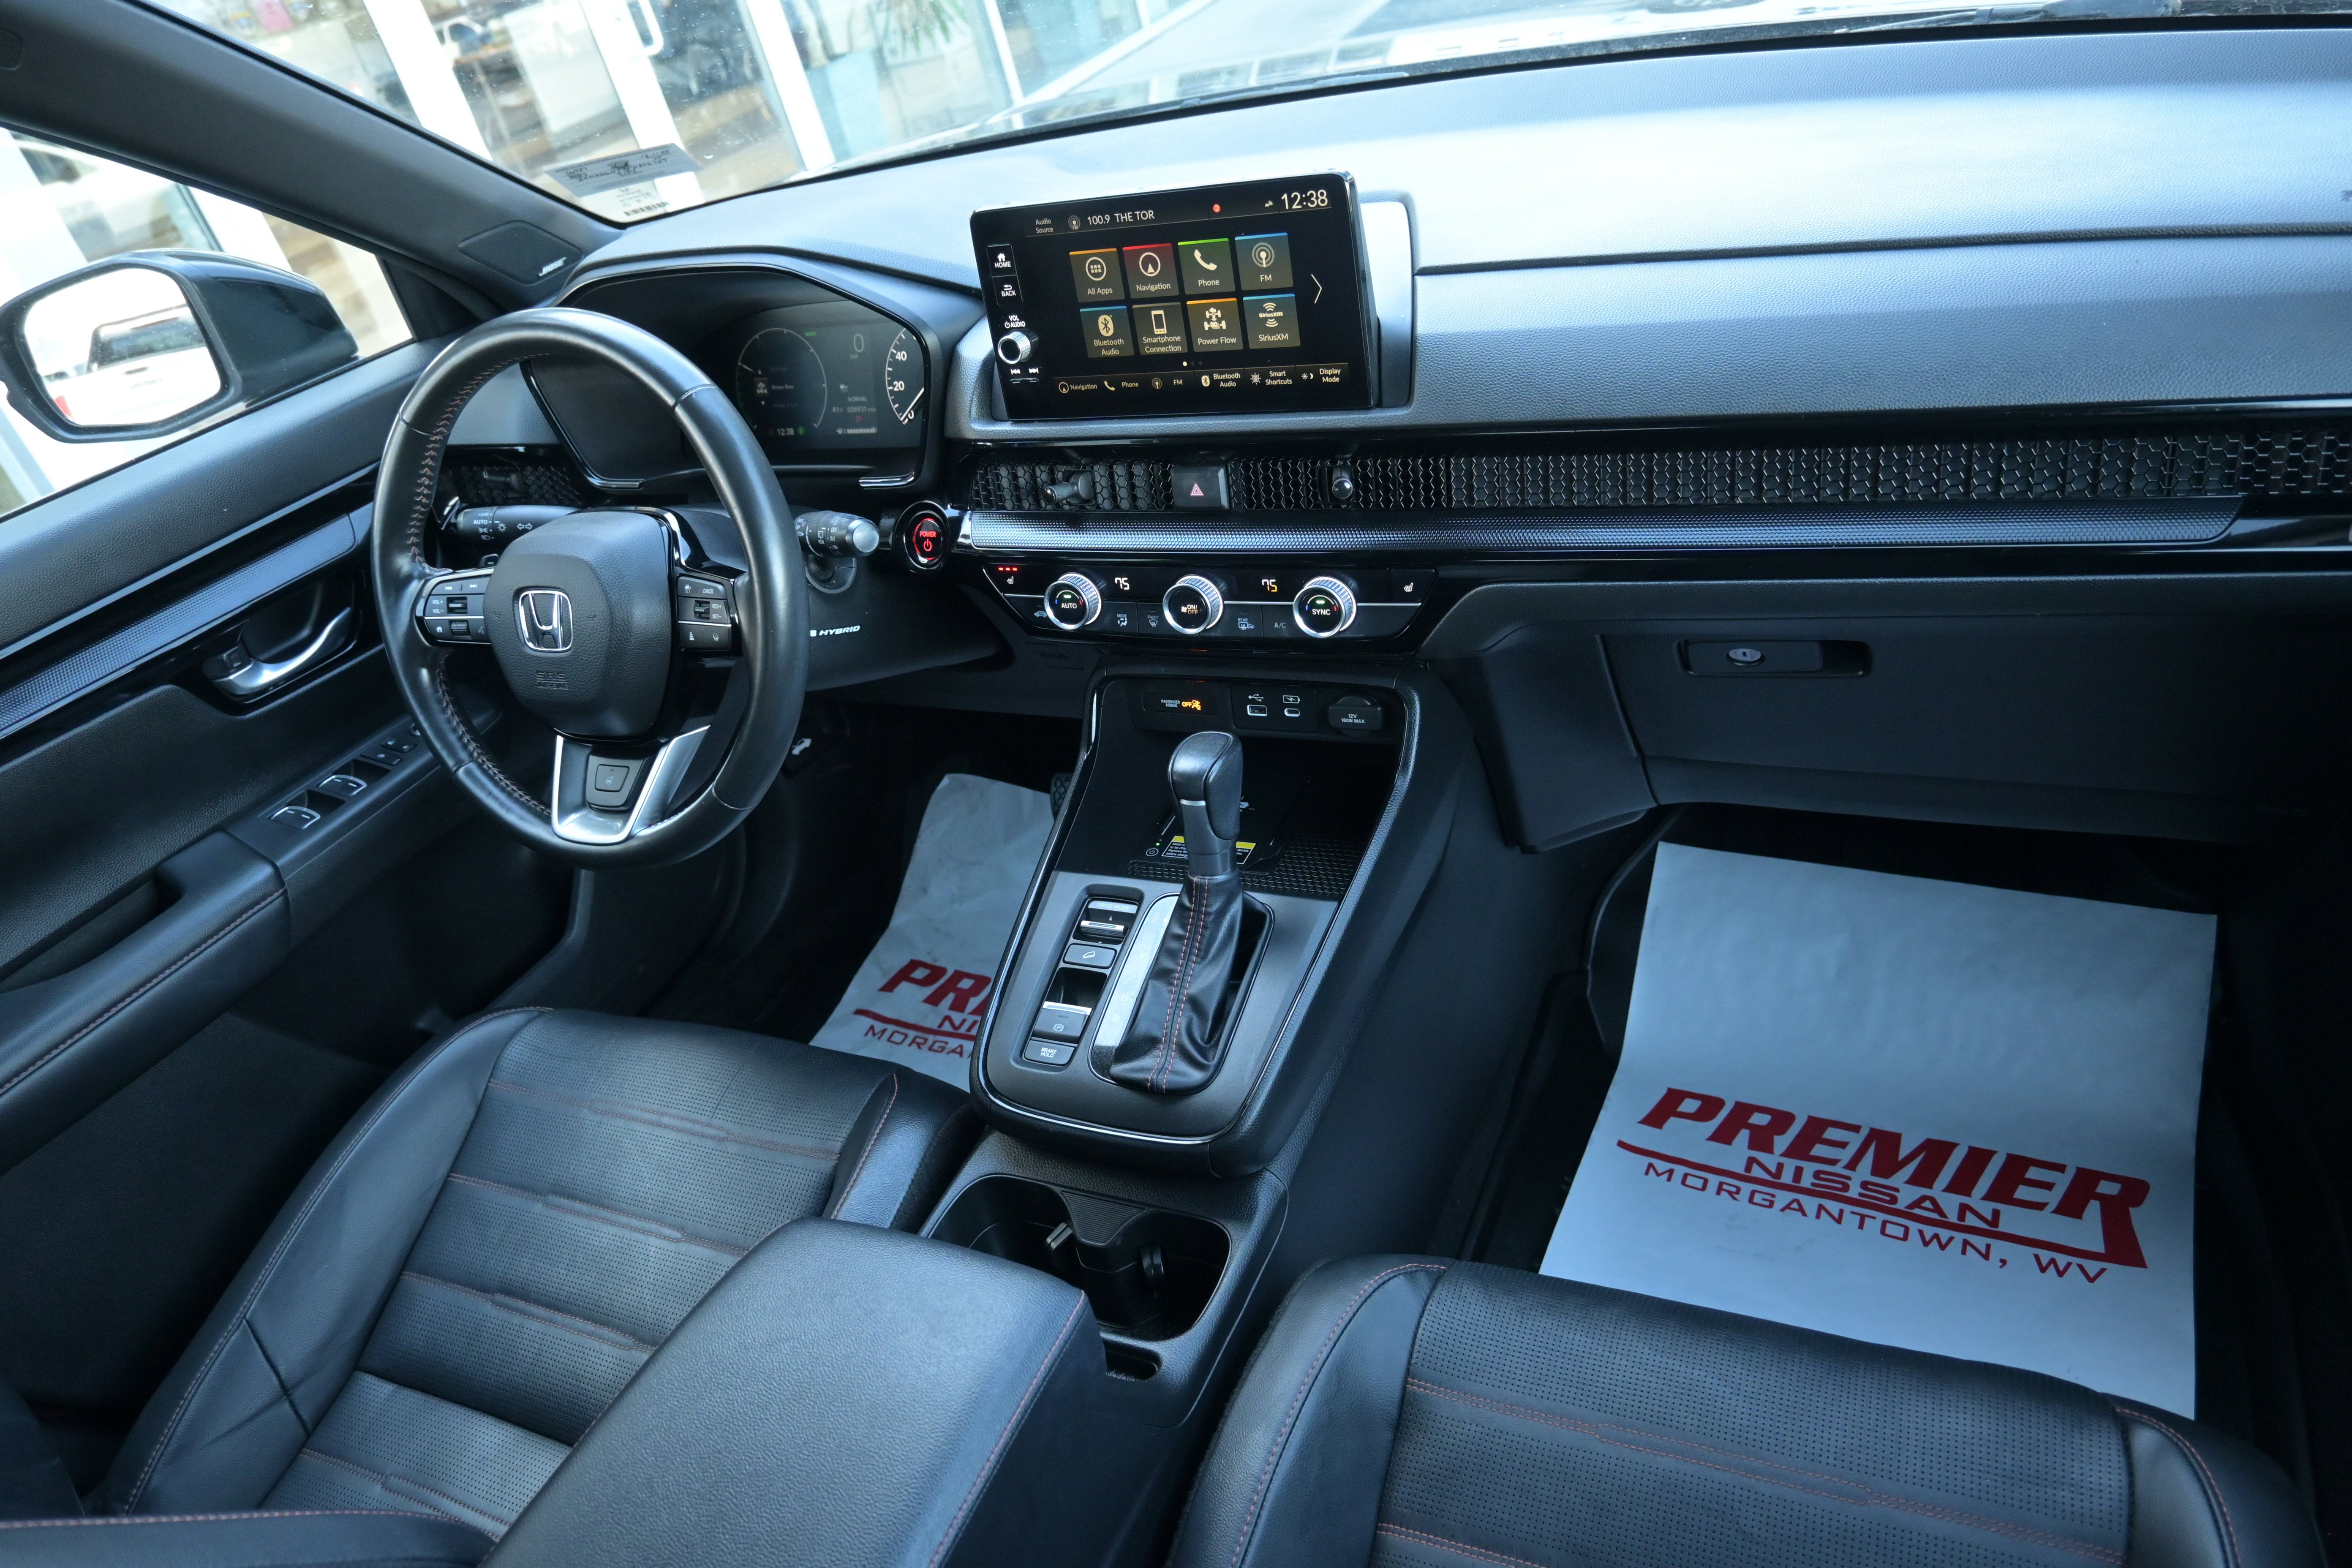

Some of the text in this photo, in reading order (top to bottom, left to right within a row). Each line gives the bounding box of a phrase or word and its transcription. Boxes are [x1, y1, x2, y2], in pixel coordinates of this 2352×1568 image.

[1281, 189, 1328, 210] 12:38
[1087, 210, 1155, 226] 100.9 THE TOR
[1136, 282, 1171, 292] Navigation
[1198, 279, 1220, 287] Phone
[1093, 338, 1124, 346] Bluetooth
[1142, 335, 1181, 344] Smartphone
[1198, 336, 1237, 345] Power Flow
[1258, 333, 1289, 342] SiriusXM
[1145, 344, 1181, 353] Connection
[895, 351, 907, 361] 40
[893, 381, 905, 391] 20
[908, 410, 915, 419] 0
[1115, 577, 1130, 591] 75
[1262, 579, 1277, 592] 75
[819, 625, 860, 636] HYBRID
[1636, 1087, 2151, 1268] PREMIER
[1743, 1156, 2001, 1229] NISSAN
[1643, 1162, 2108, 1284] MORGANTOWN, WV
